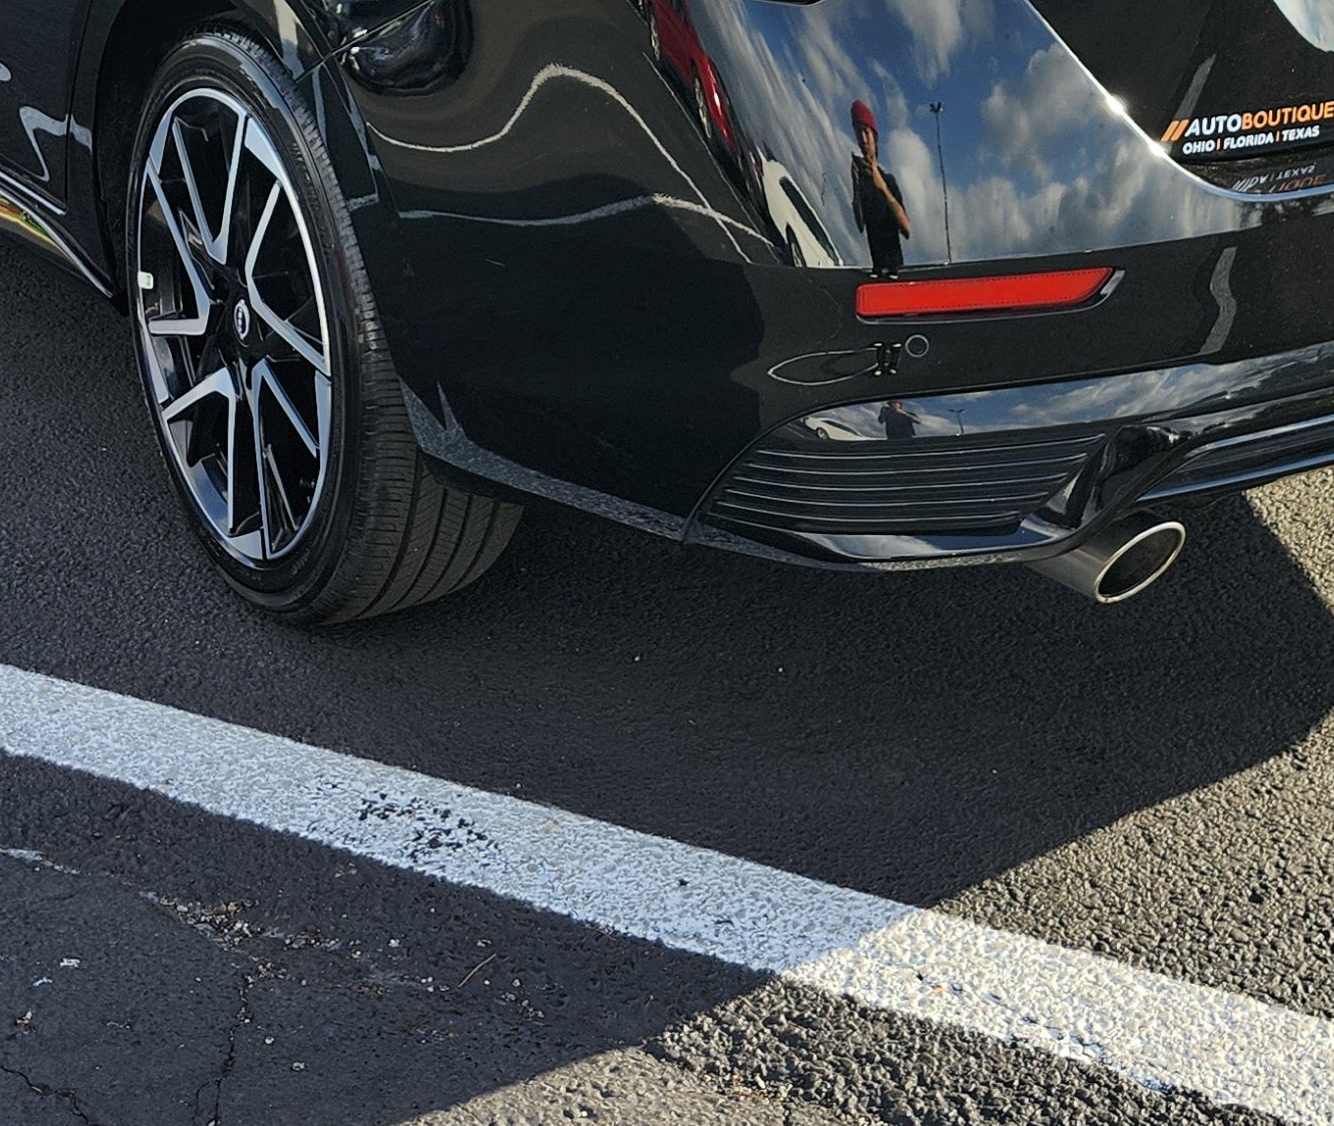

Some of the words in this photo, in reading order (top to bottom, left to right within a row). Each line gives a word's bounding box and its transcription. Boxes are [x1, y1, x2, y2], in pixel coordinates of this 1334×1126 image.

[1182, 140, 1215, 155] OHIO
[1223, 133, 1274, 151] FLORIDA
[1281, 125, 1320, 142] TEXAS
